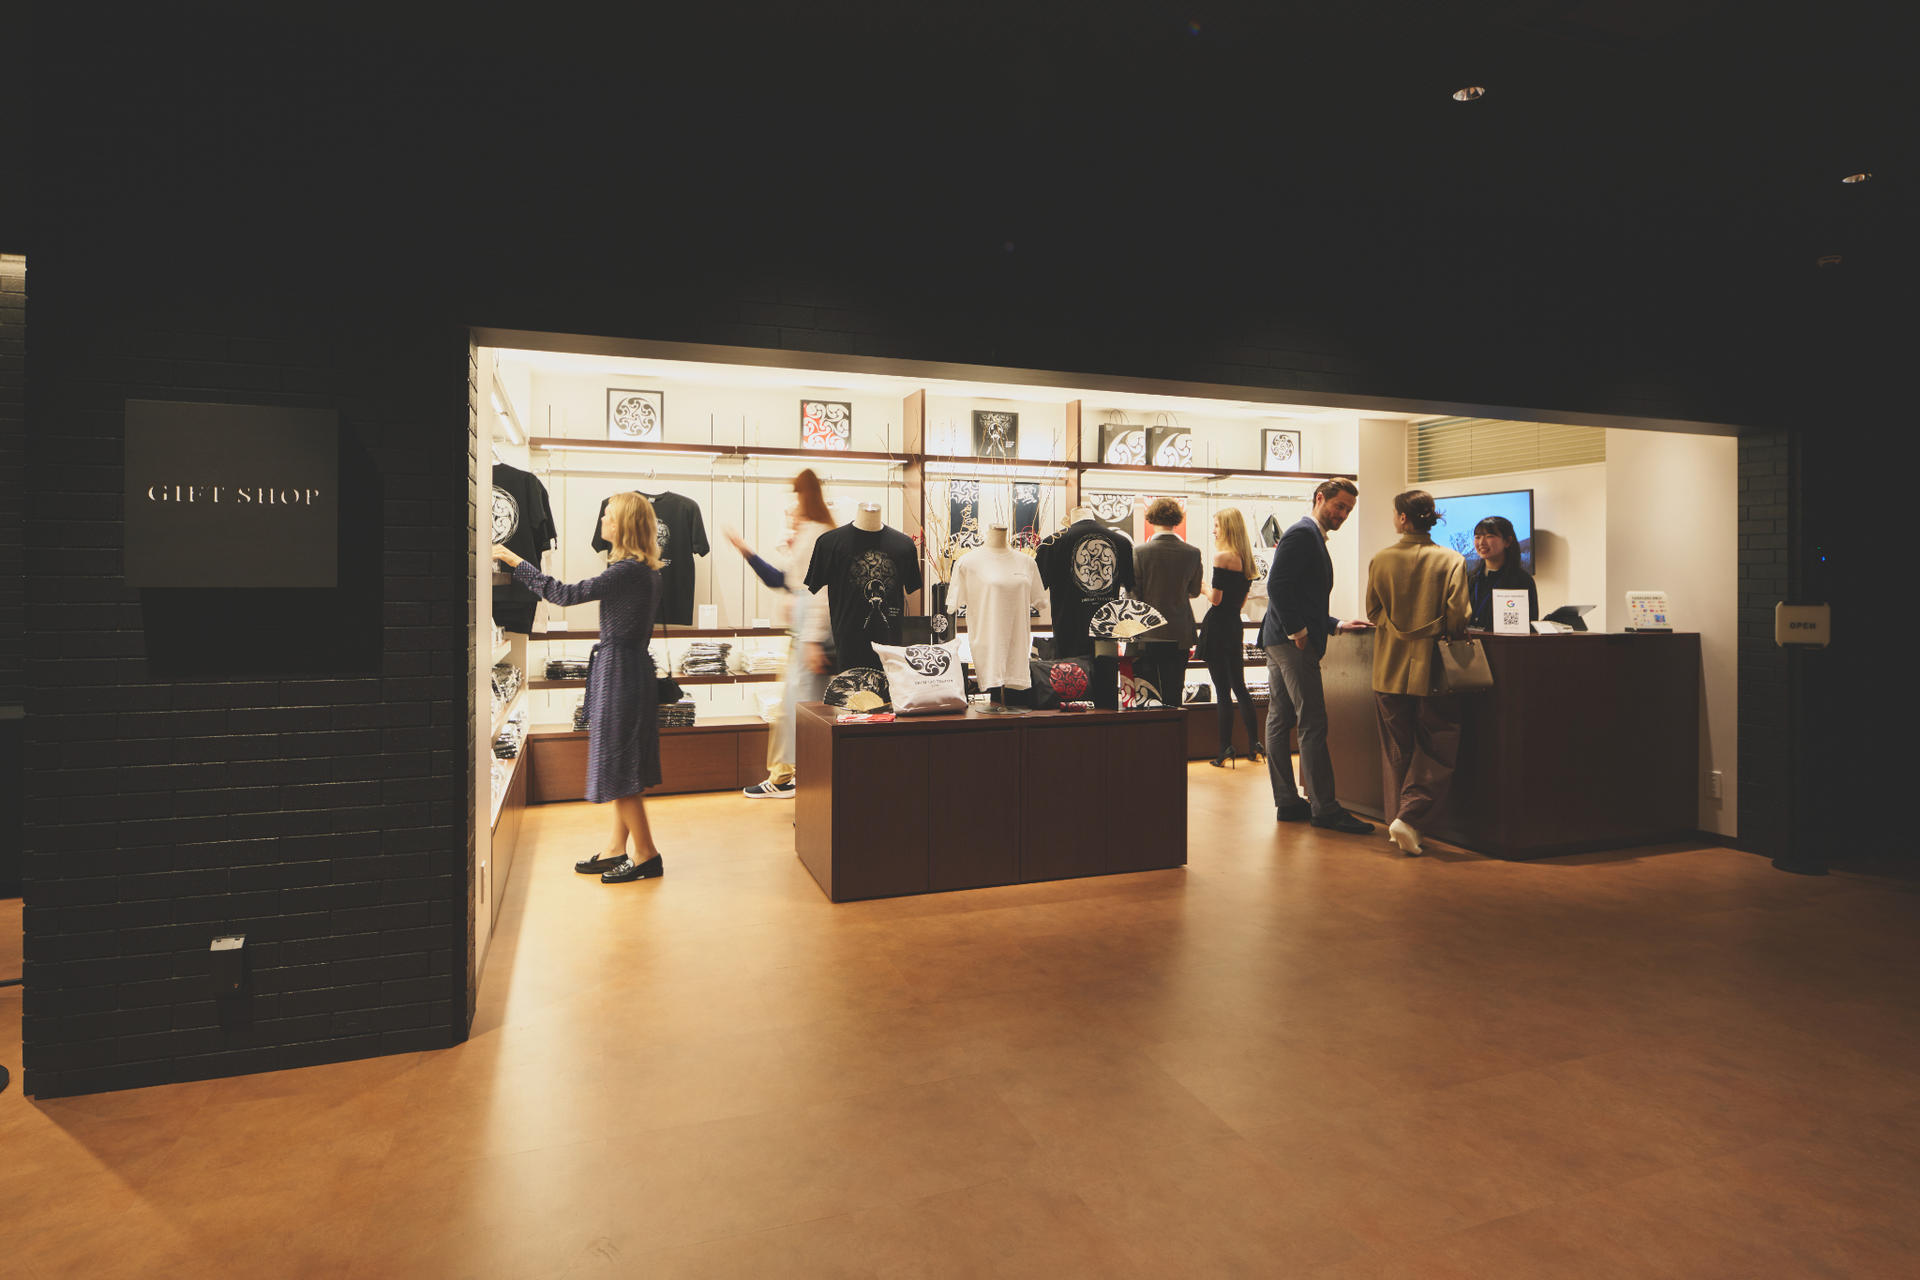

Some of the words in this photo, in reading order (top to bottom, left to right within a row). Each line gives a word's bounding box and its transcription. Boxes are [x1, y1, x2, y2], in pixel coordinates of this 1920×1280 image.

[148, 485, 225, 503] GIFT
[237, 487, 320, 505] SHOP
[1789, 621, 1817, 630] OPEN
